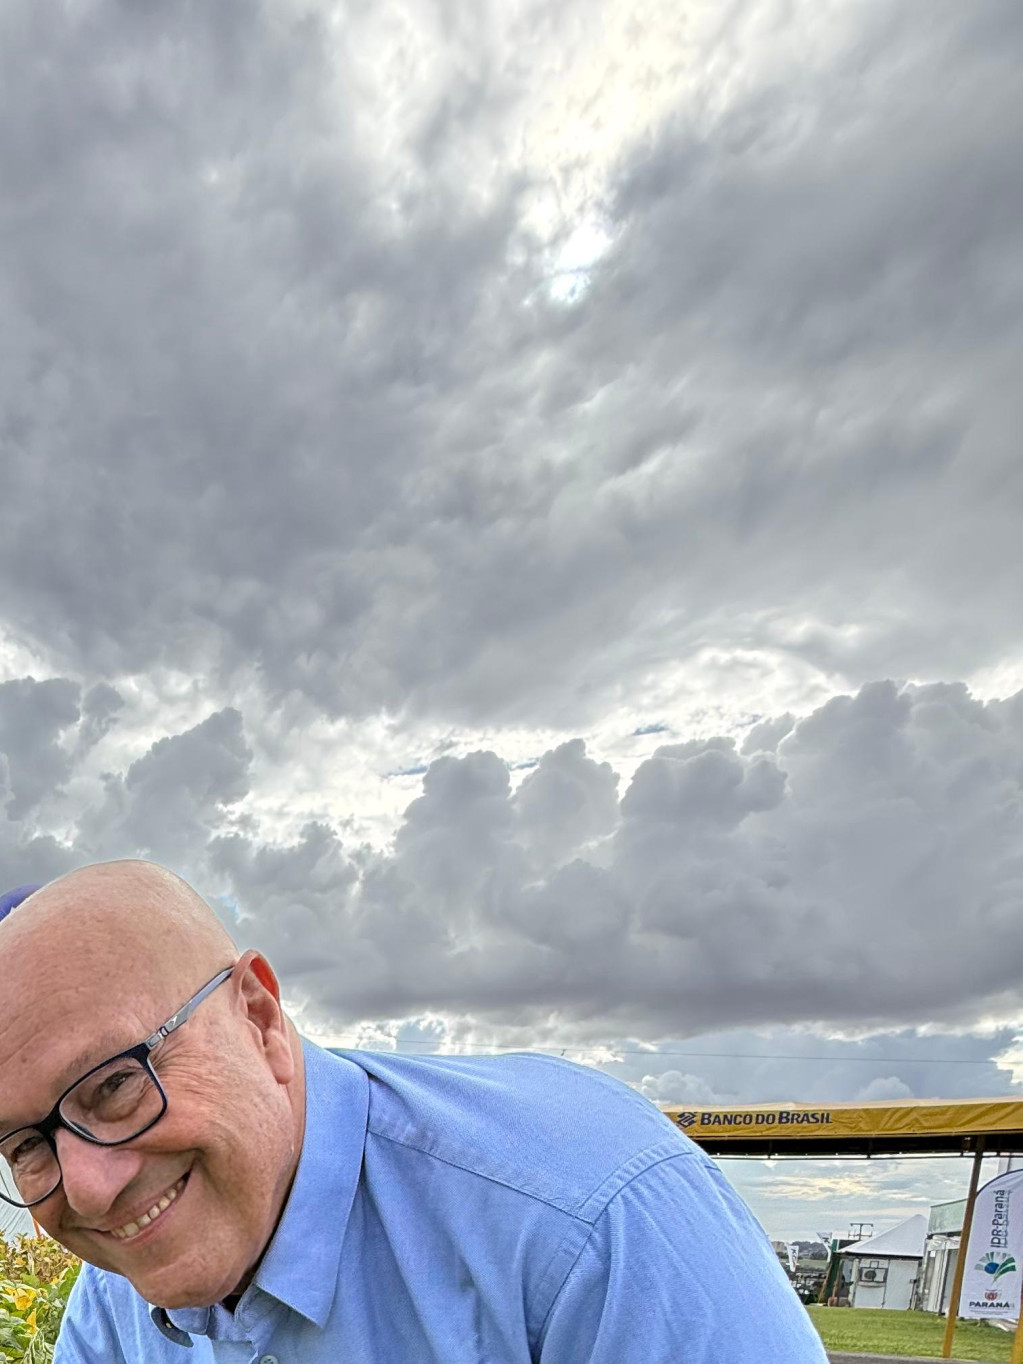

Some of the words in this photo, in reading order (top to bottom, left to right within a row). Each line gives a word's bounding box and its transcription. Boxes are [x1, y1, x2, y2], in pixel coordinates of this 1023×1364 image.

[700, 1112, 752, 1126] BANCO
[755, 1113, 775, 1125] DO
[778, 1111, 833, 1125] BRASIL
[990, 1189, 1006, 1248] IDR-Paraná
